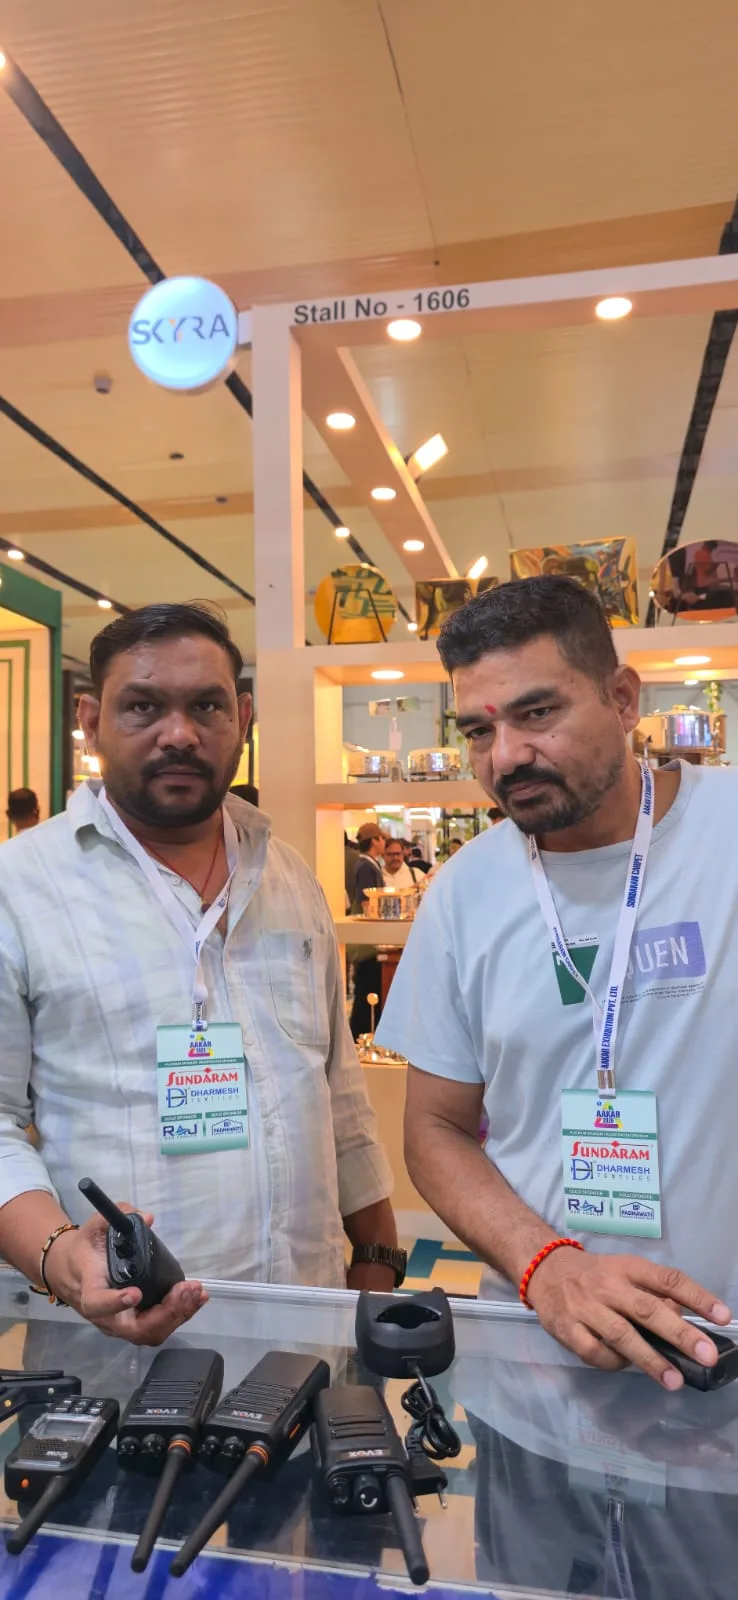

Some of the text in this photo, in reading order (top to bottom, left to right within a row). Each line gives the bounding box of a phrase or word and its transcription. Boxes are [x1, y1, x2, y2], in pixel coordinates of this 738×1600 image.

[294, 304, 346, 324] Stall
[354, 297, 388, 318] No
[413, 288, 471, 312] 1606
[132, 313, 231, 345] SKYRA
[166, 1071, 239, 1087] SUNDARAM
[190, 1087, 239, 1097] DHARMESH
[571, 1141, 650, 1160] SUNDARAM
[596, 1164, 650, 1174] DHARMESH
[231, 1410, 263, 1420] EVOX
[348, 1449, 384, 1458] EVOX
